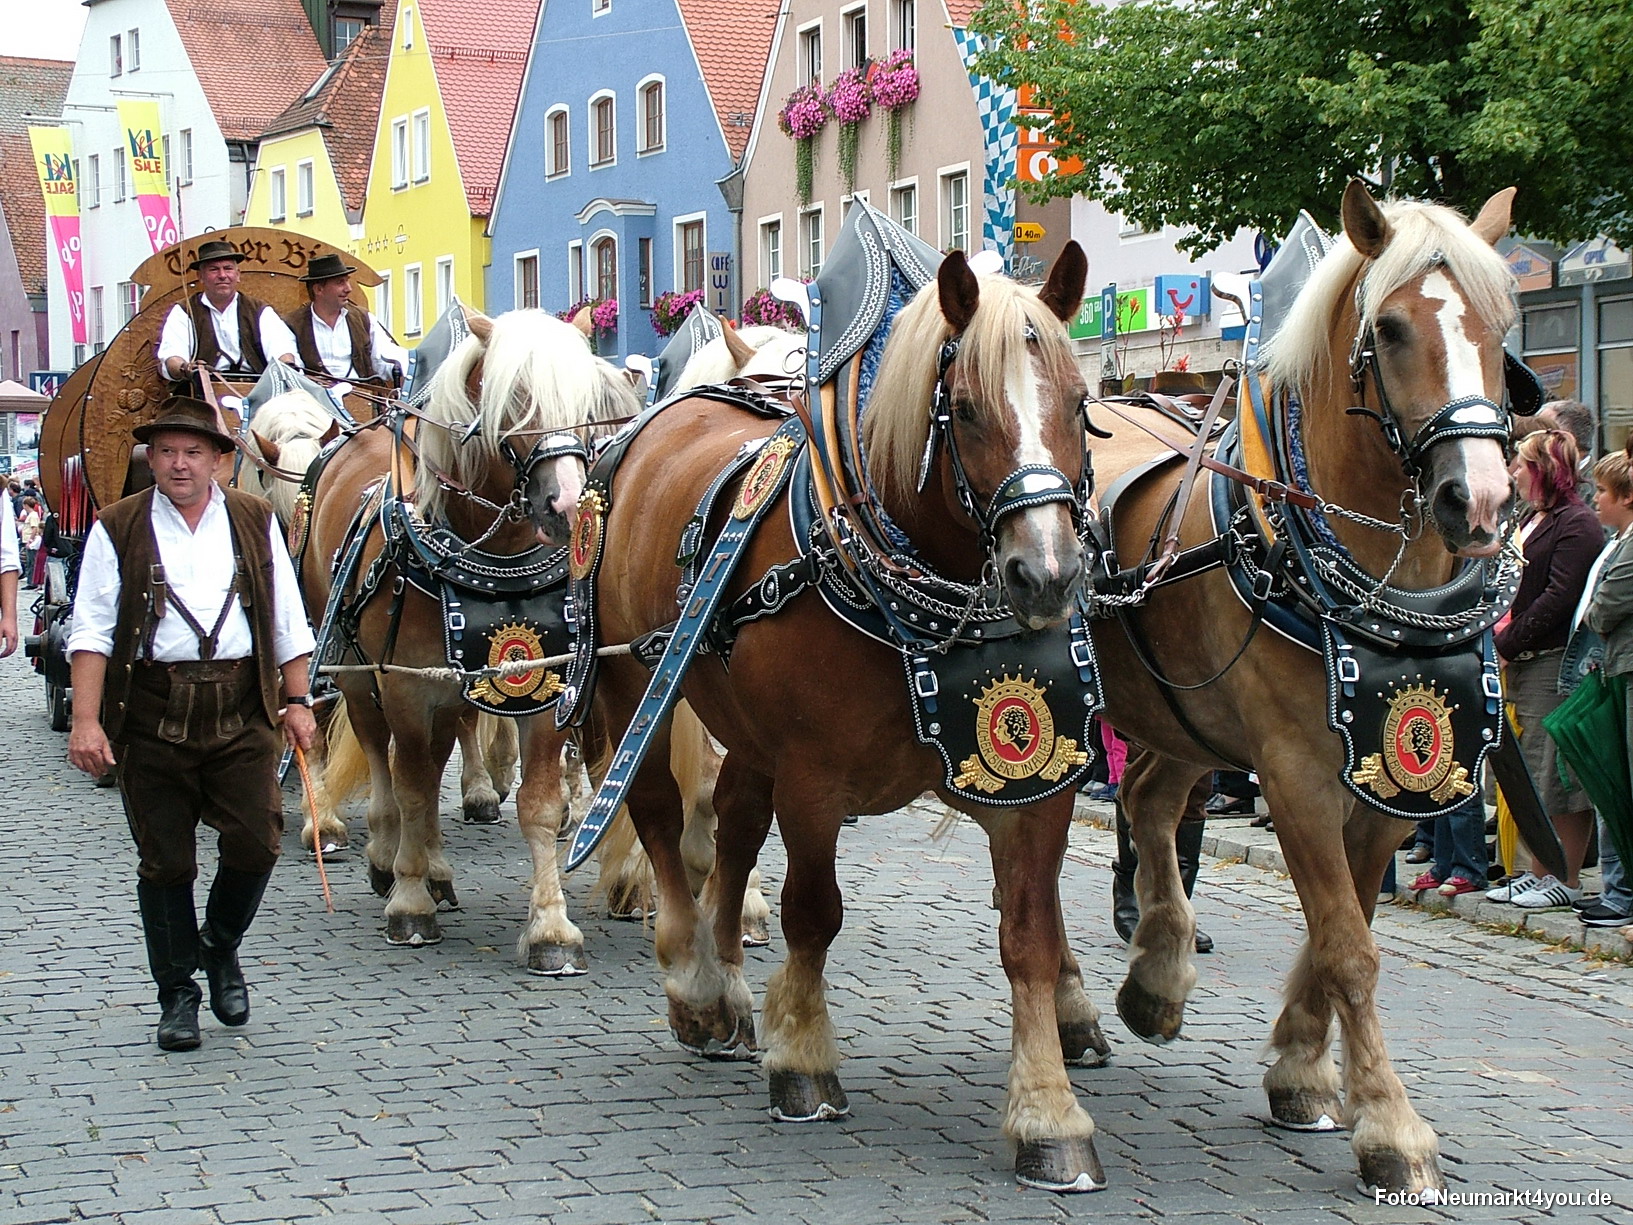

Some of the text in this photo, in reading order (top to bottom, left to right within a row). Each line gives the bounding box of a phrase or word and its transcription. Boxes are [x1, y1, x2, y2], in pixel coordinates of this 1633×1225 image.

[133, 159, 161, 174] SALE
[1080, 302, 1094, 325] 360
[1105, 293, 1113, 334] P
[978, 704, 1053, 777] TUCHER BIERE IN ALLER WELT
[1386, 718, 1400, 759] TUCHER
[1440, 724, 1453, 754] WELT
[979, 774, 996, 789] SEIT
[1389, 759, 1415, 788] BIERE
[1417, 777, 1428, 789] IN
